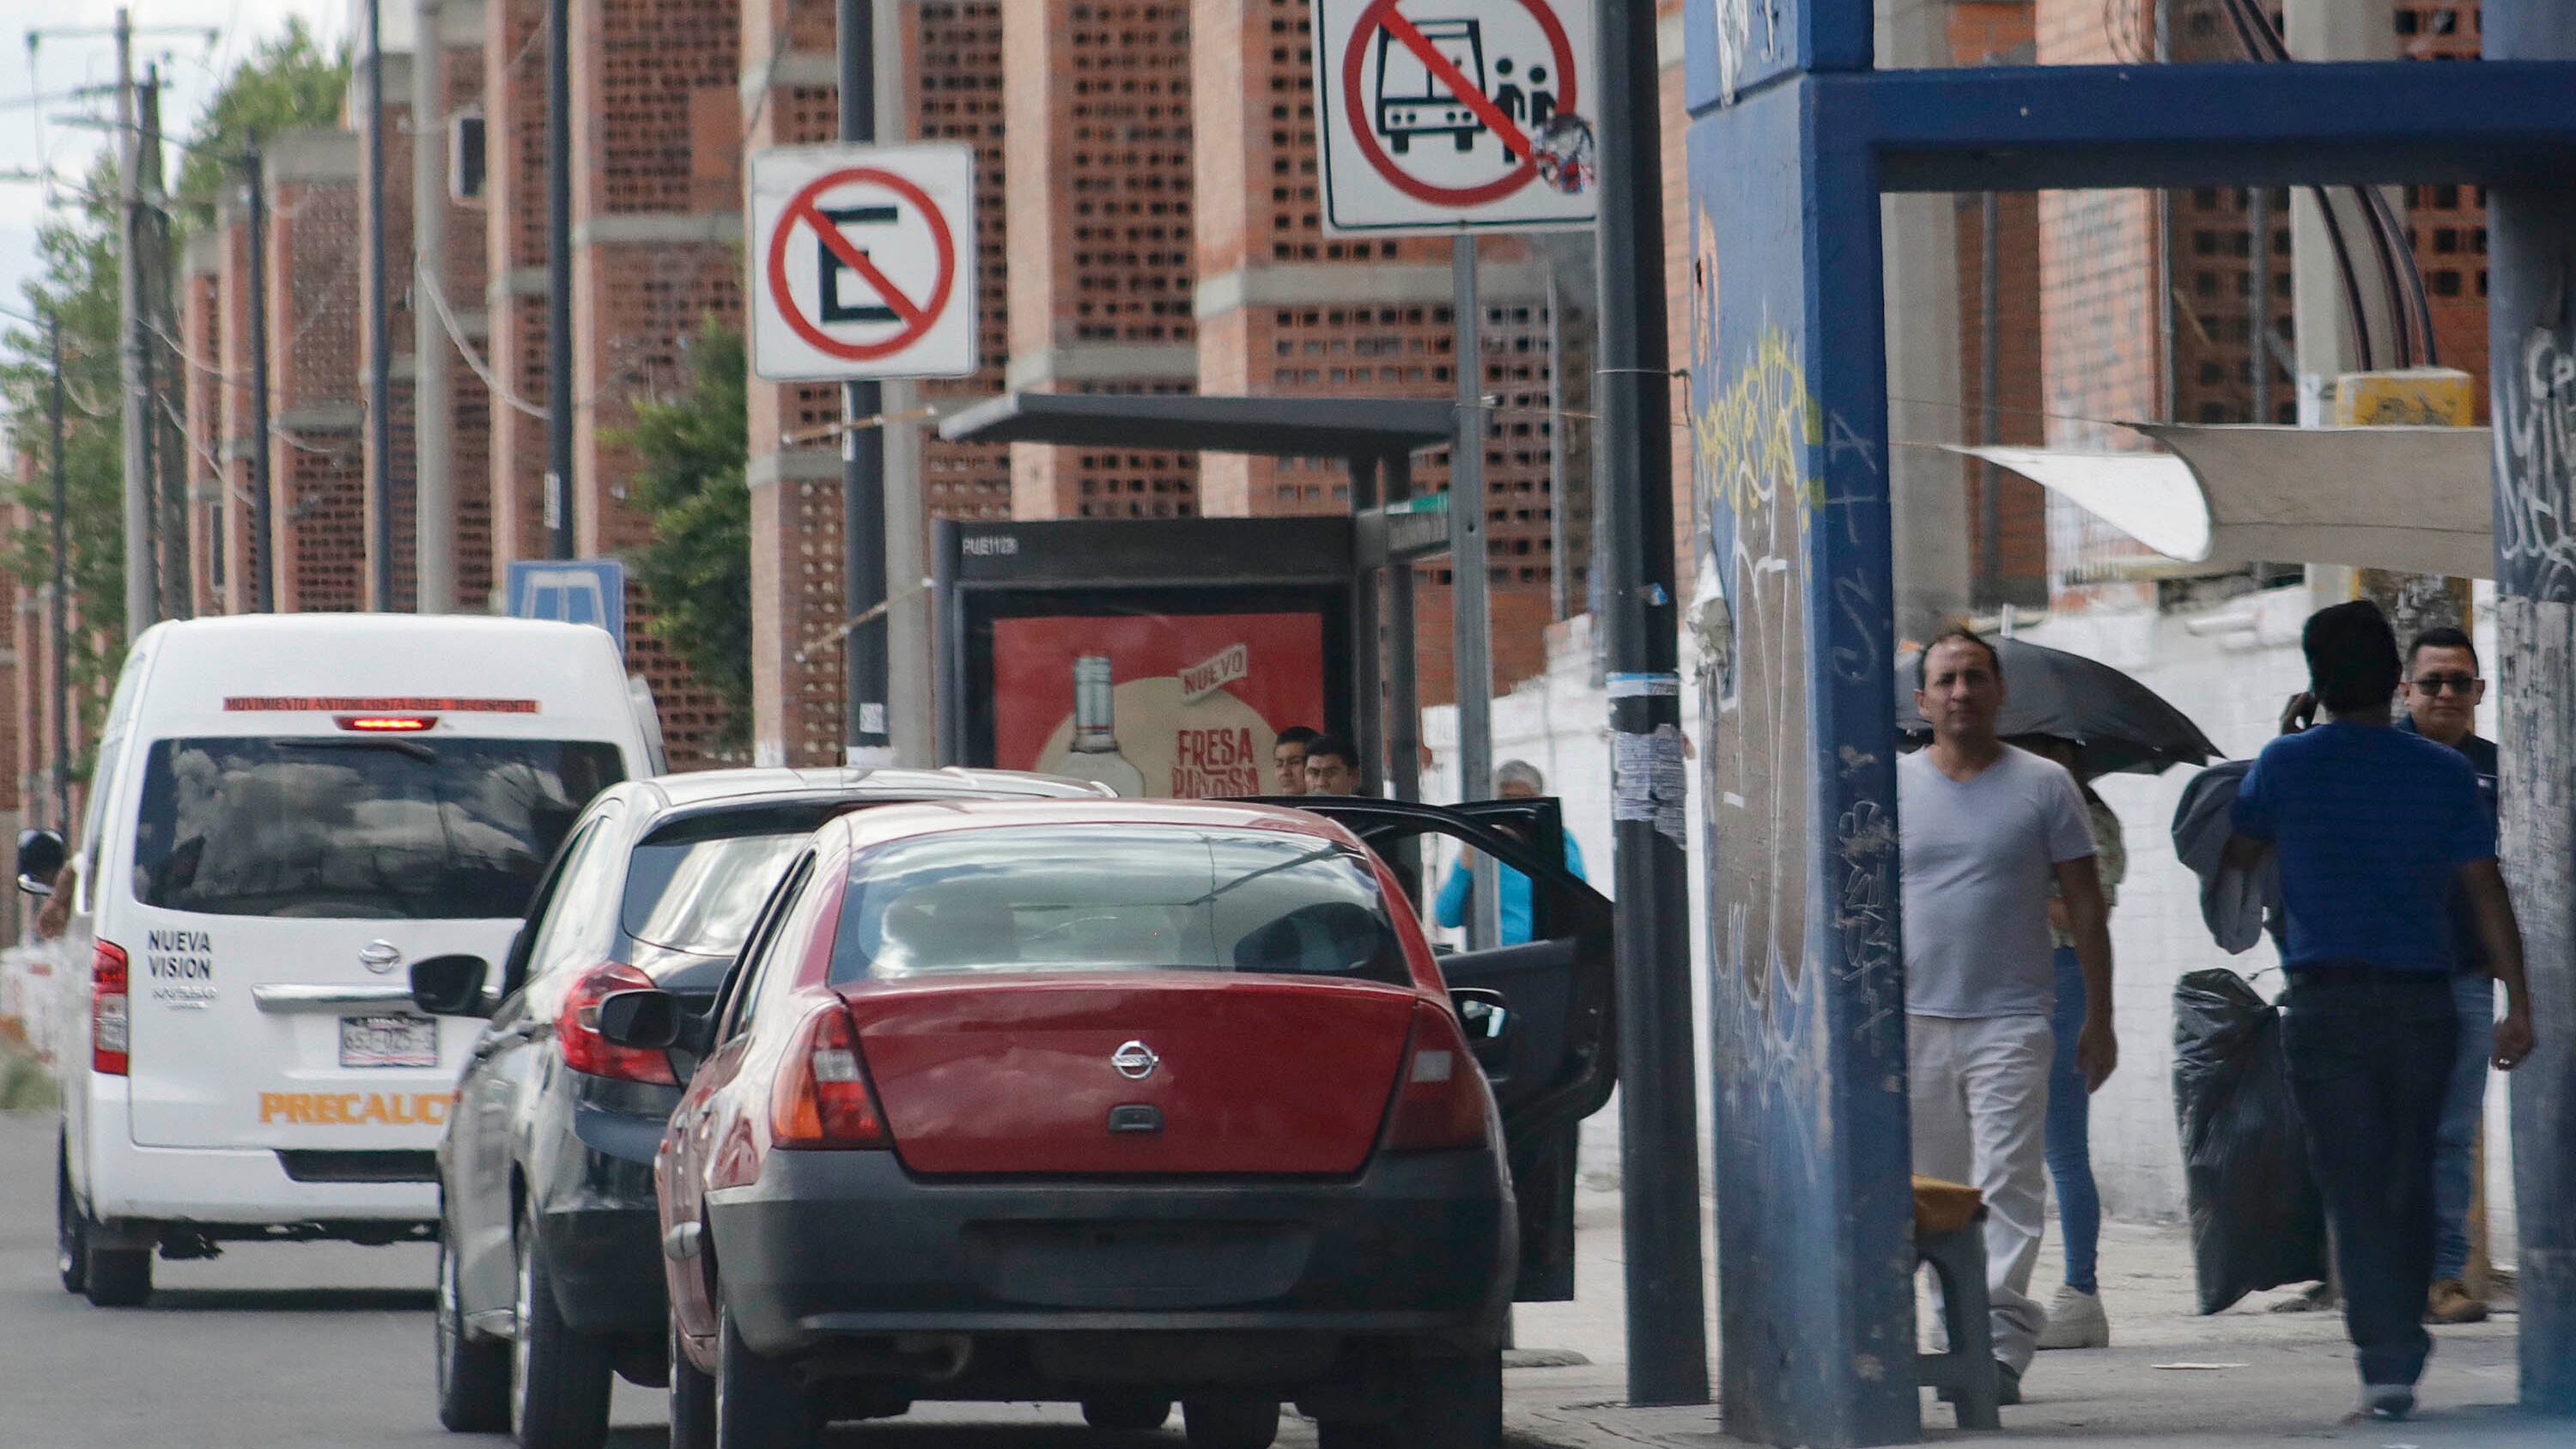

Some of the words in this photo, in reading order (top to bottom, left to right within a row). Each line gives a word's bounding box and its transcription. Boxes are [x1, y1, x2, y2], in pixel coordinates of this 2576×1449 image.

[818, 204, 899, 325] E
[1182, 650, 1243, 697] NUEVO
[1177, 728, 1255, 775] FRESA
[147, 929, 212, 953] NUEVA
[147, 955, 211, 979] VISION
